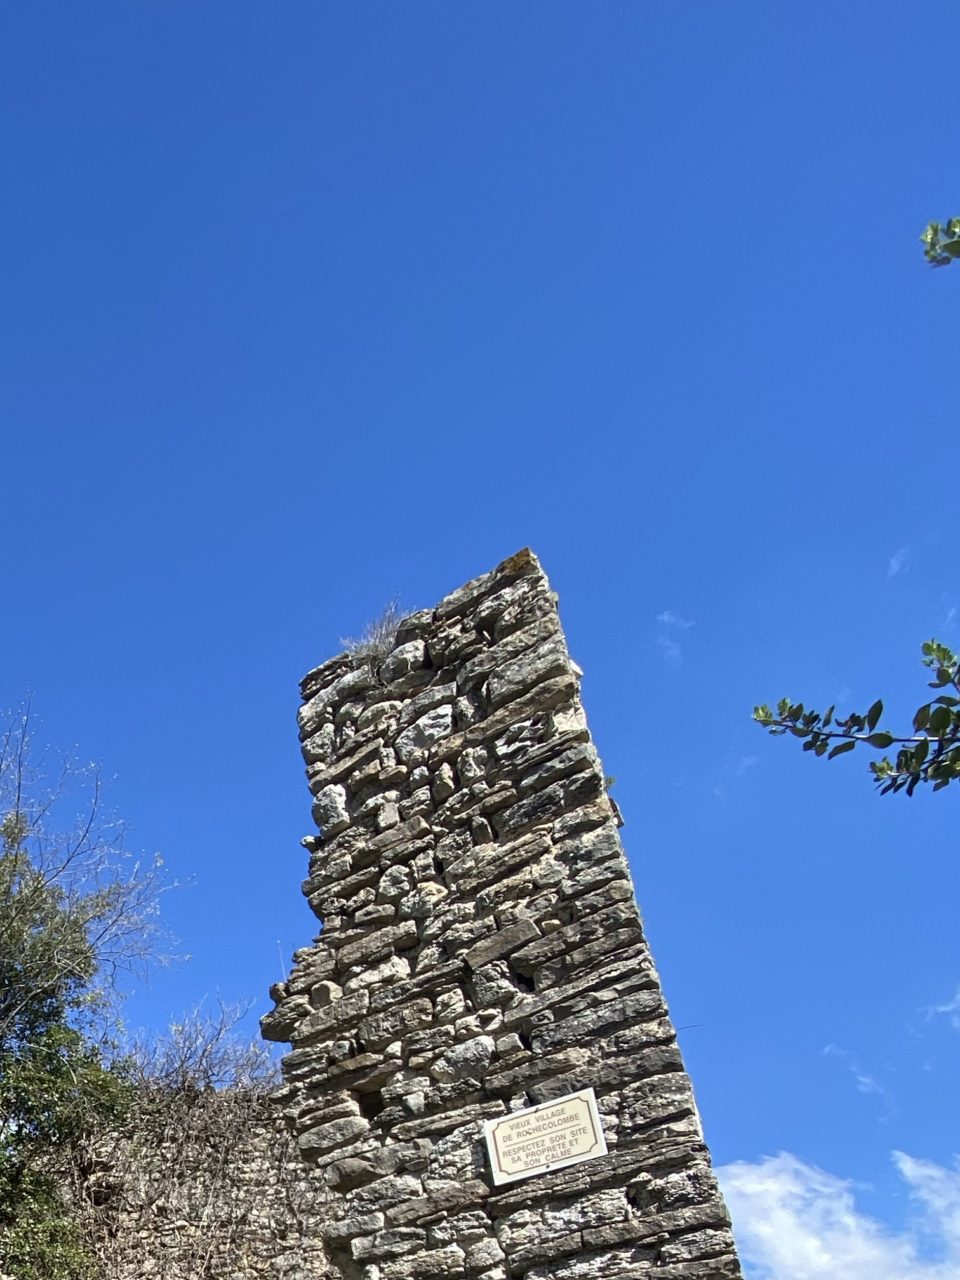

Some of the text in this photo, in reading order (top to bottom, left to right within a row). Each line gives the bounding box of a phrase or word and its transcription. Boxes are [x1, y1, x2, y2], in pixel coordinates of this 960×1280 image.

[509, 1108, 566, 1131] VIEUX VILLAGE
[517, 1113, 580, 1138] ROCHECOLOMBE
[502, 1127, 587, 1158] RESPECTEZ SON SITE
[511, 1155, 522, 1163] SA
[569, 1138, 579, 1146] ET
[524, 1148, 572, 1167] SON CALME
